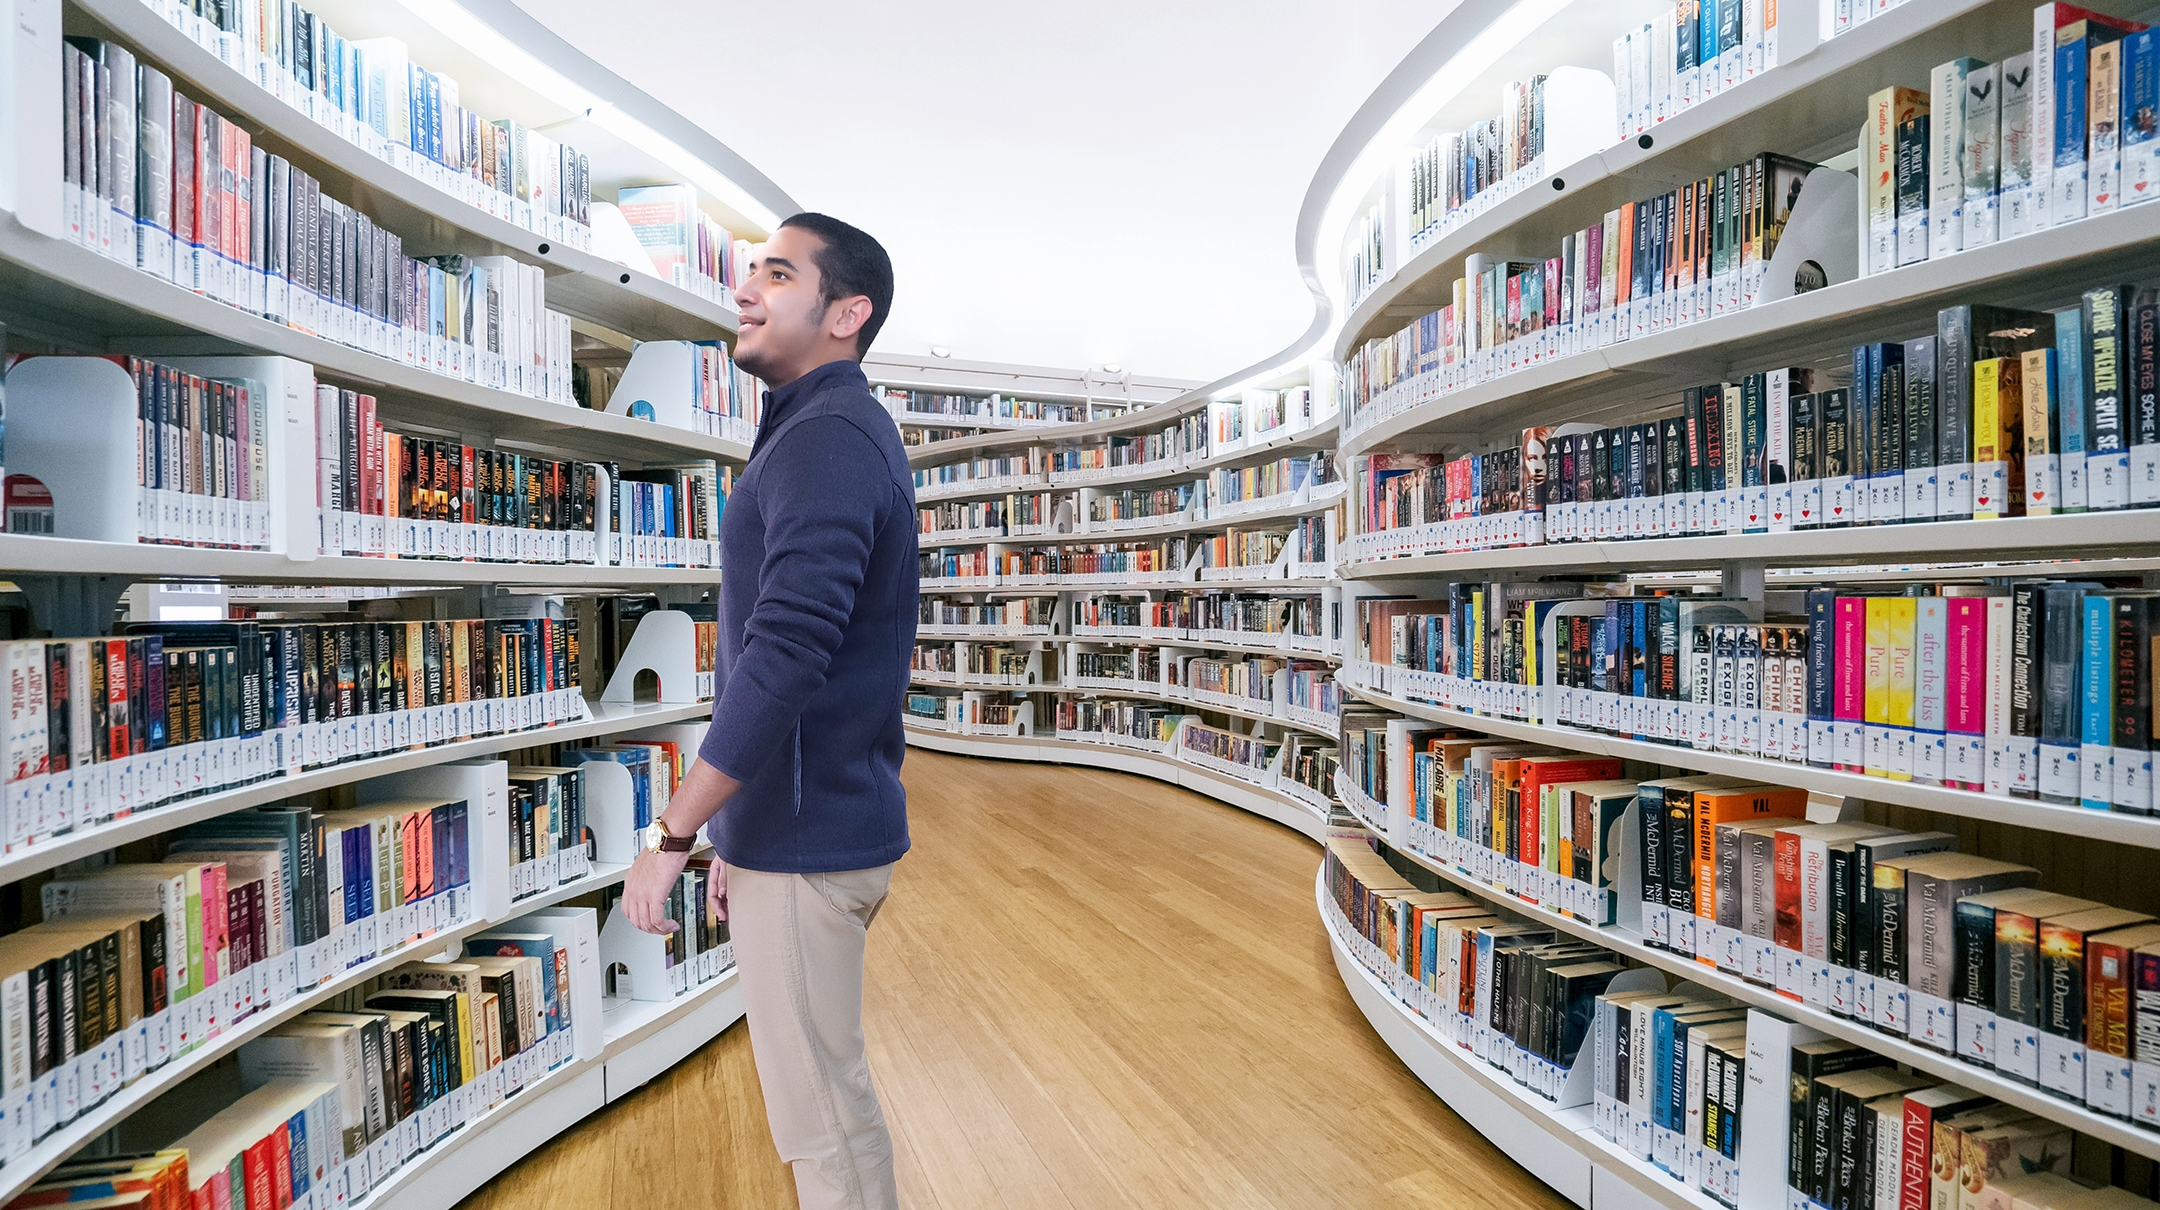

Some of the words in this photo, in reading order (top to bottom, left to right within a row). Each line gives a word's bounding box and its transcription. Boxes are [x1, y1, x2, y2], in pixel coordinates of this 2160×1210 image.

[1879, 101, 1889, 136] Feather
[1879, 140, 1889, 163] Man
[1911, 143, 1922, 174] ROBERT
[296, 185, 304, 243] CARNIVAL
[2092, 290, 2115, 334] SOPHIE
[2140, 309, 2154, 344] CLOSE
[2140, 345, 2153, 361] MY
[2140, 363, 2154, 390] EYES
[366, 412, 374, 434] WOMAN
[1747, 396, 1757, 418] FATAL
[2096, 396, 2118, 430] SPLIT
[2141, 393, 2154, 431] SOPHIE
[366, 434, 374, 451] WITH
[1705, 396, 1721, 467] INDEXING
[1747, 420, 1757, 446] STRIKE
[1773, 438, 1781, 458] KILL
[366, 457, 374, 470] GUN
[1726, 450, 1733, 460] TO
[1506, 588, 1526, 597] LIAM
[2017, 591, 2031, 604] The
[1663, 621, 1674, 647] WALK
[1814, 619, 1826, 641] being
[2015, 606, 2031, 656] Charlestown
[2088, 609, 2102, 658] multiple
[285, 631, 293, 668] MARIANI
[1815, 642, 1825, 669] friends
[1869, 646, 1885, 678] Pure
[1894, 647, 1910, 678] Pure
[1923, 633, 1940, 665] after
[2119, 619, 2134, 706] KILOMETER
[1662, 655, 1673, 690] SILENCE
[1700, 657, 1708, 704] GERML
[1772, 664, 1780, 711] CHIME
[1815, 671, 1824, 688] with
[1922, 669, 1939, 692] the
[2013, 656, 2031, 709] Connection
[2087, 660, 2101, 704] listings
[170, 687, 180, 703] THE
[243, 675, 251, 730] UNIDENTIFIED
[251, 674, 260, 728] UNIDENTIFIED
[1813, 690, 1824, 708] boys
[1921, 695, 1939, 721] kiss
[169, 706, 181, 745] BURNING
[1434, 746, 1445, 793] MACABRE
[1700, 800, 1710, 815] VAL
[1753, 798, 1770, 813] VAL
[300, 832, 310, 877] MARTIN
[379, 850, 389, 873] LIFE
[1647, 820, 1660, 877] McDermid
[1752, 840, 1763, 858] Val
[1778, 853, 1787, 875] Point
[1784, 839, 1795, 881] Vanishing
[282, 848, 291, 912] PURGATORY
[380, 880, 389, 894] PI
[1701, 864, 1712, 918] NORTHANGER
[1753, 861, 1763, 914] McDermid
[1807, 851, 1820, 912] Retribution
[1835, 859, 1846, 897] Beneath
[1923, 882, 1936, 902] Val
[271, 870, 281, 926] PURGATORY
[347, 884, 357, 919] SELF
[363, 879, 372, 915] SELF
[1834, 910, 1846, 952] Bleeding
[1883, 900, 1898, 965] McDermid
[1922, 904, 1937, 968] McDermid
[2009, 951, 2025, 1012] McDermid
[2107, 987, 2127, 1015] VAL
[419, 1022, 428, 1055] WHITE
[1674, 1039, 1684, 1057] SOFT
[1750, 1050, 1764, 1060] MAC
[362, 1032, 373, 1085] MASTERTON
[420, 1057, 431, 1093] BONES
[371, 1086, 379, 1115] TAKEN
[1672, 1058, 1683, 1108] Apocalypse
[1707, 1103, 1718, 1140] STRANGE
[1816, 1106, 1829, 1143] Broken
[1877, 1119, 1885, 1157] DEIRDRE
[1876, 1159, 1884, 1198] MADDEN
